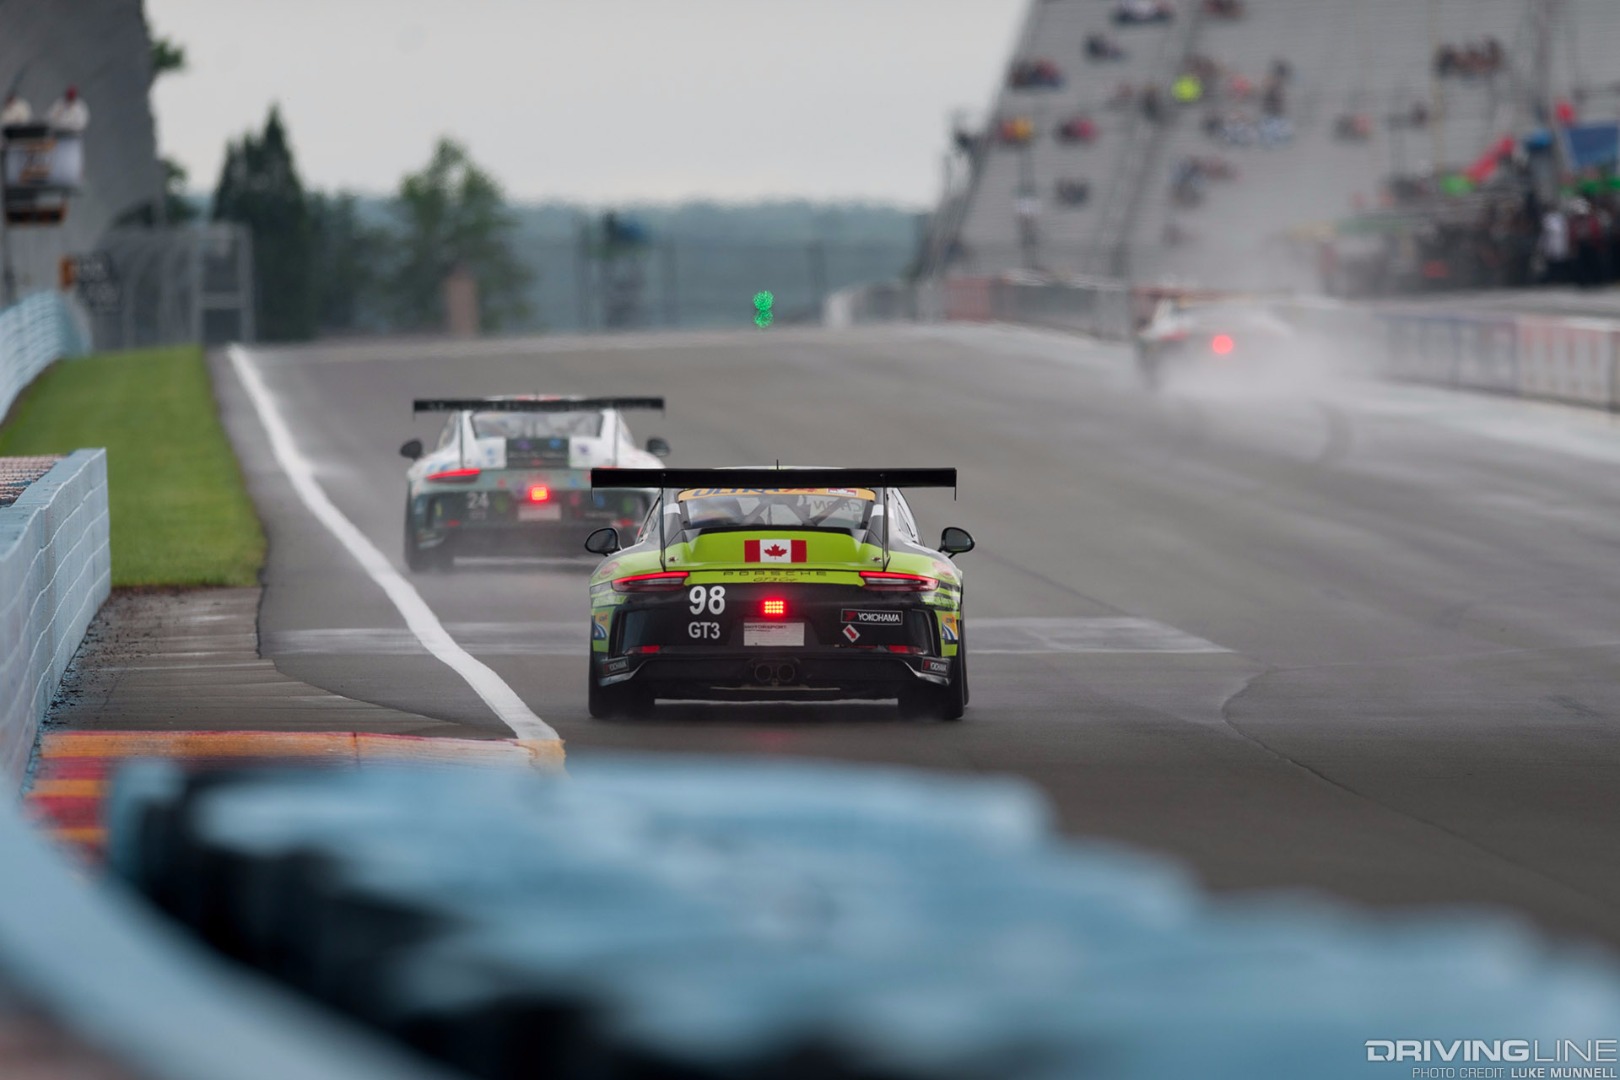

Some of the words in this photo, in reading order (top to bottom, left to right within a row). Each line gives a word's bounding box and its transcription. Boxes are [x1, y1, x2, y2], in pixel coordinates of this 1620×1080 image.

[466, 491, 490, 509] 24
[689, 586, 726, 615] 98
[858, 612, 900, 622] YOKOHAMA
[688, 622, 720, 639] GT3
